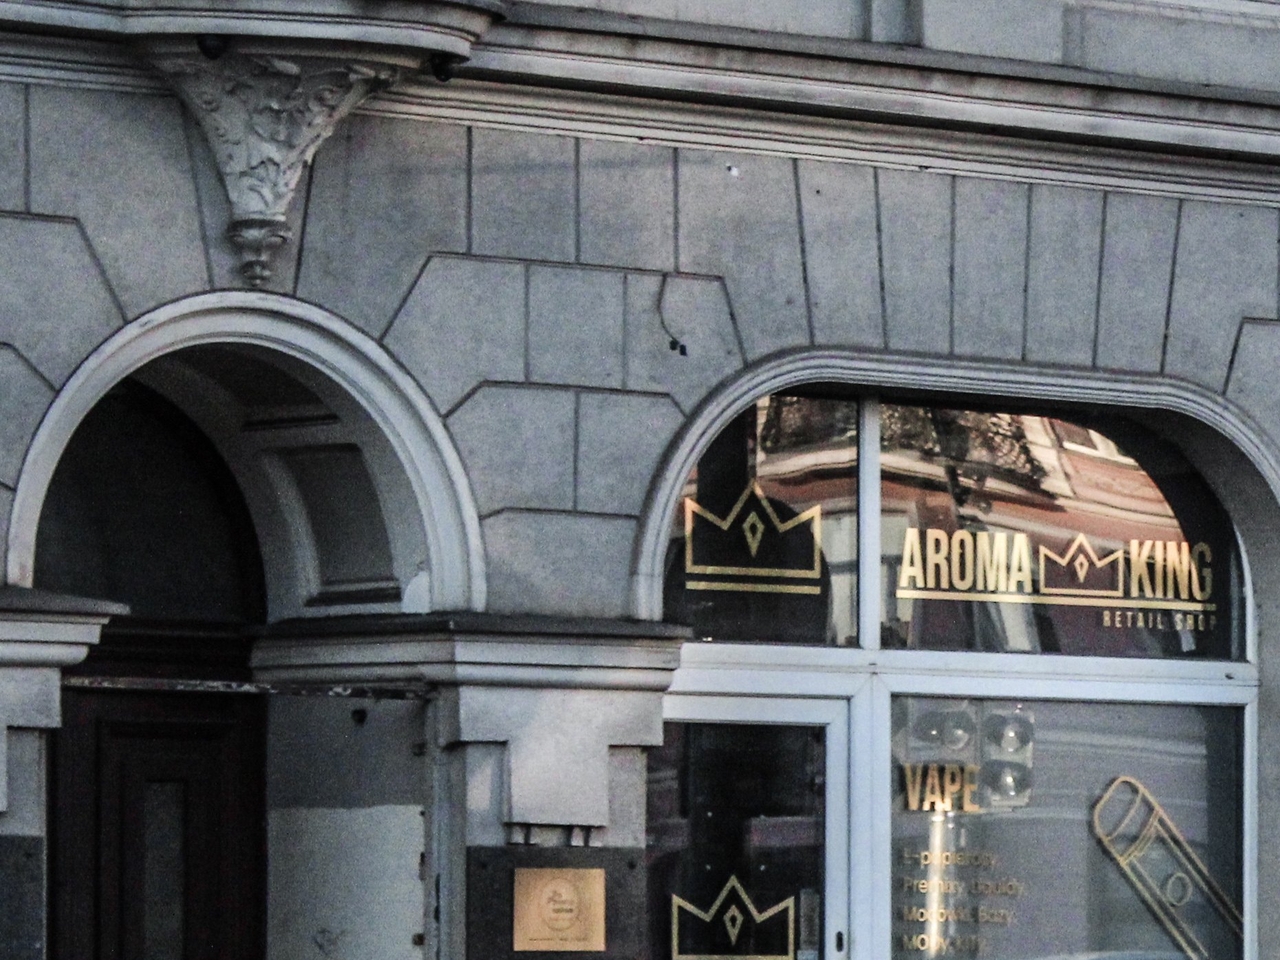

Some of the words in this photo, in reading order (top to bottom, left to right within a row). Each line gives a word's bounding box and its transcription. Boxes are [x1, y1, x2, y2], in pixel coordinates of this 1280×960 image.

[899, 527, 1033, 593] AROMA
[1129, 538, 1214, 601] KING
[1102, 610, 1164, 630] RETAIL
[1174, 613, 1217, 632] SHOP
[903, 762, 981, 812] VAPE
